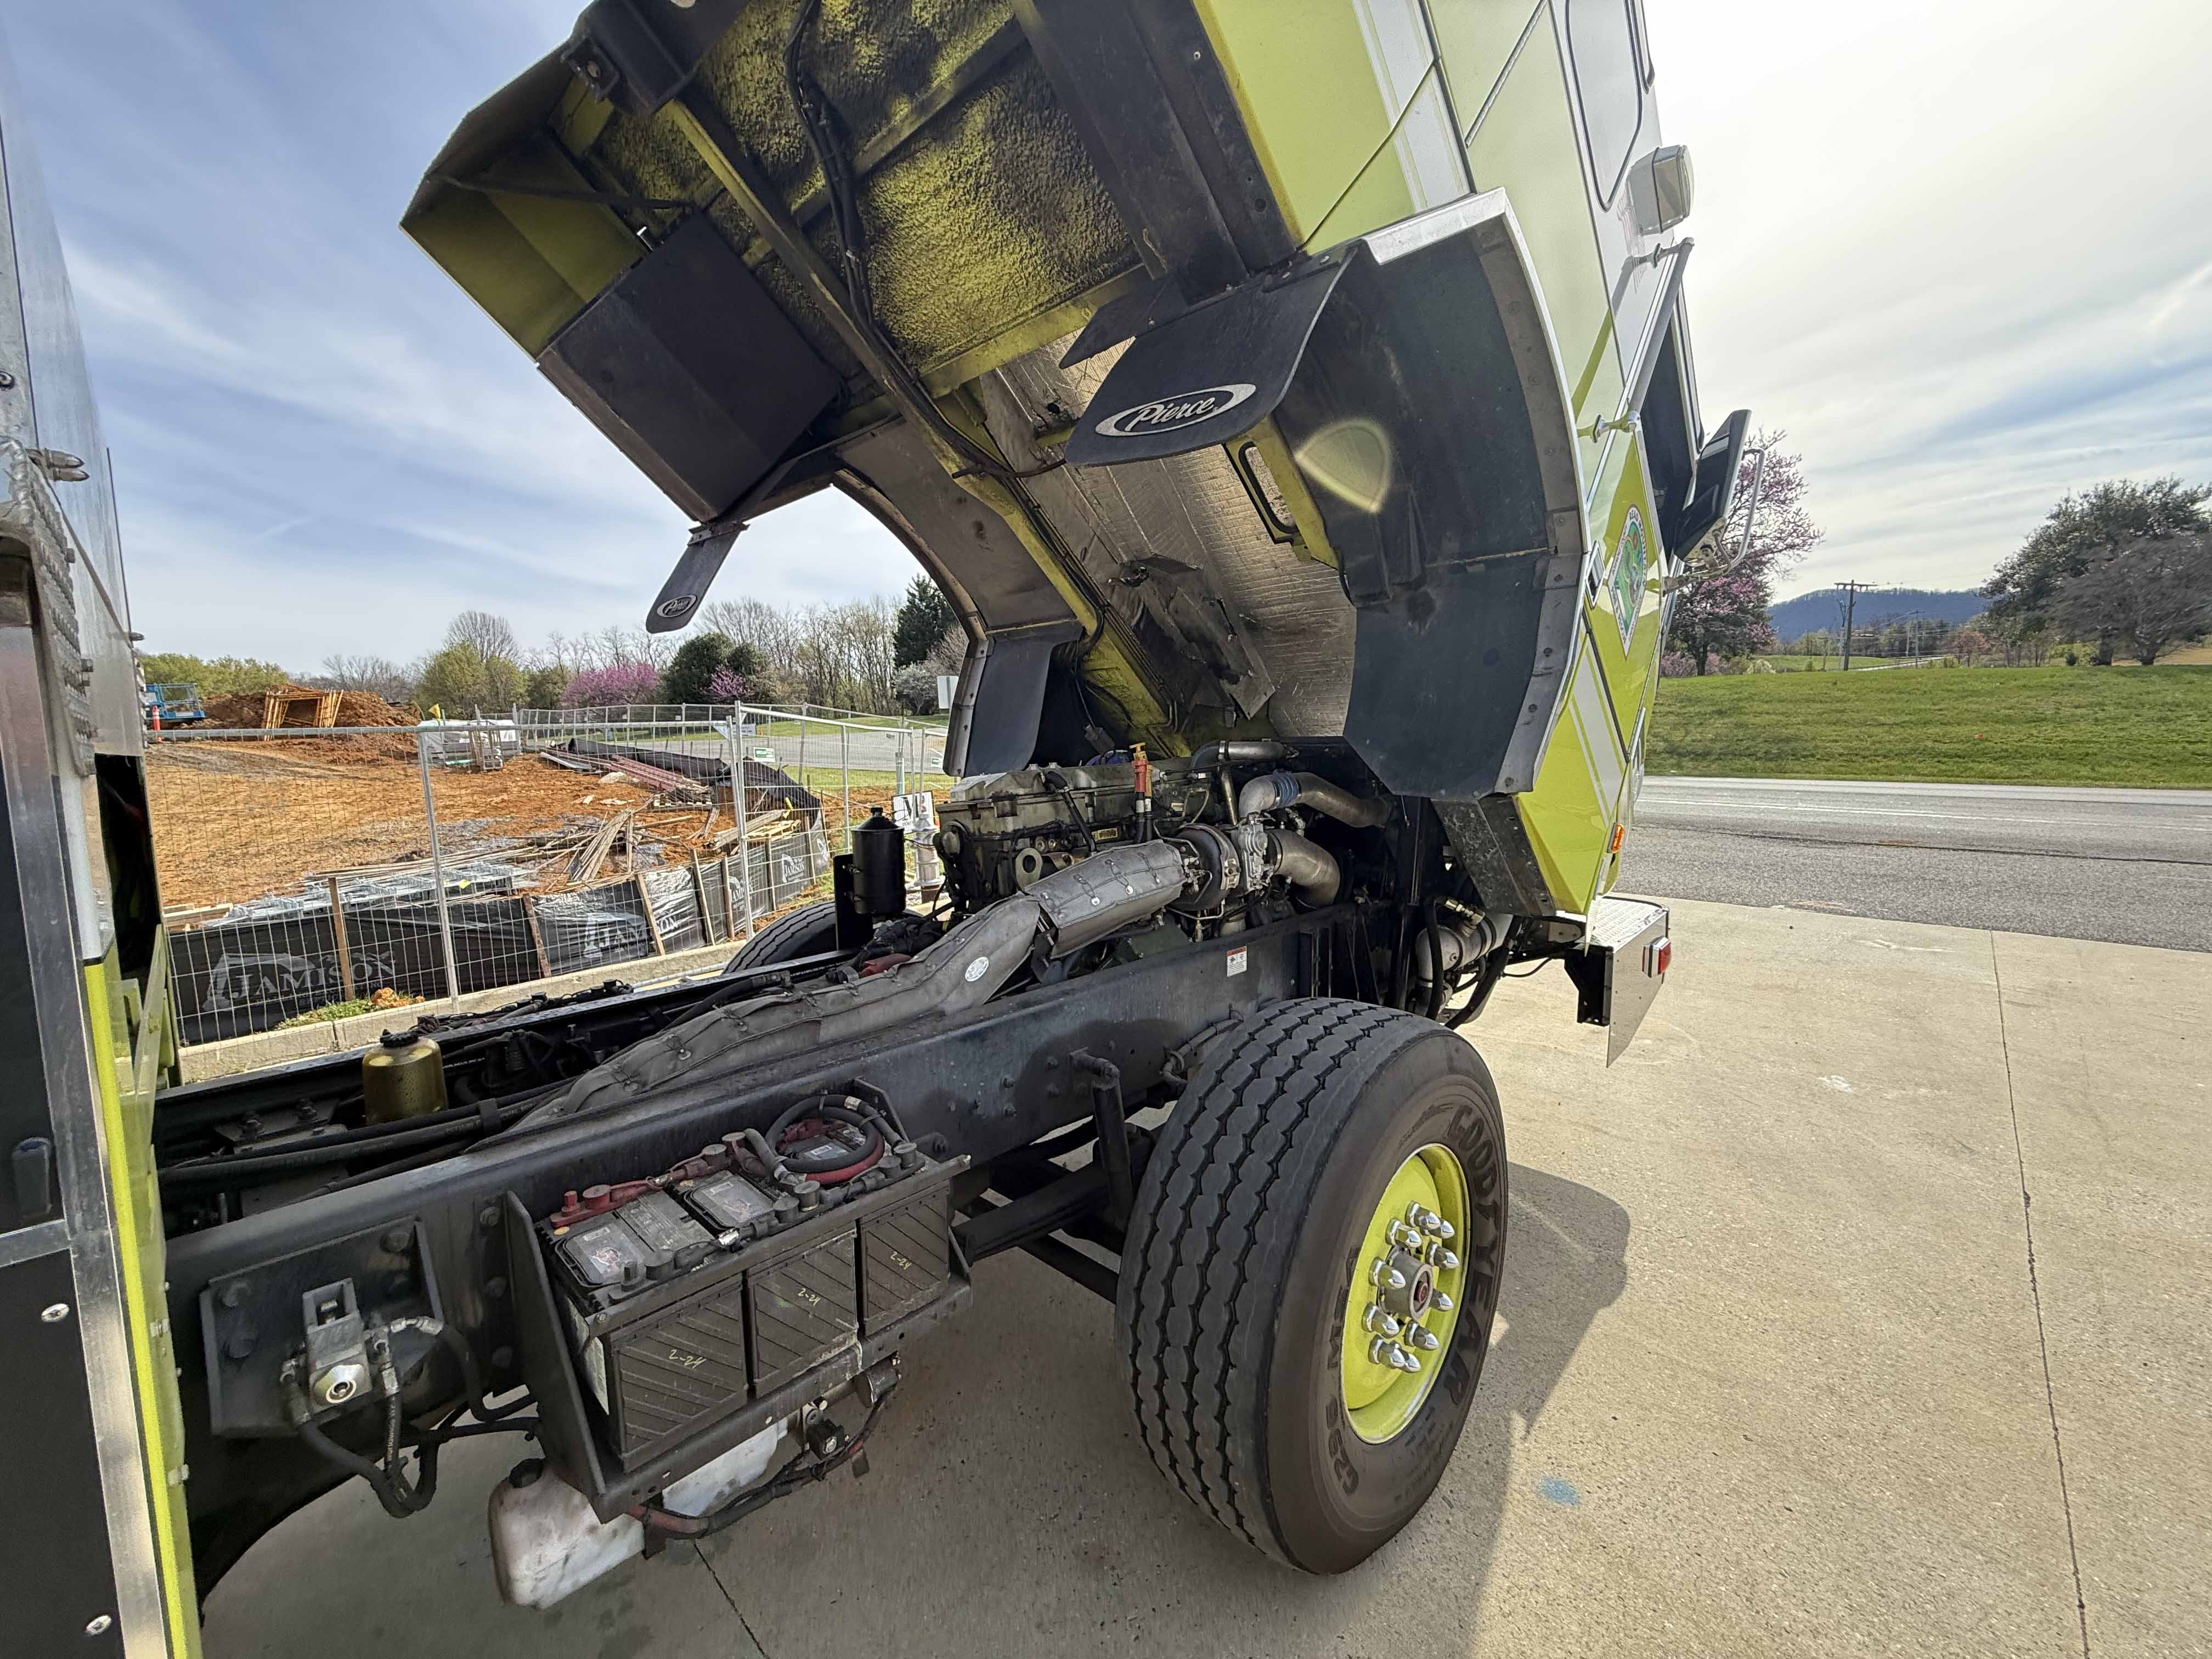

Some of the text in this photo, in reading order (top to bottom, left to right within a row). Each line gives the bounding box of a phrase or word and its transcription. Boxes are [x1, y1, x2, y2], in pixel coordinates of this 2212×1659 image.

[1124, 397, 1216, 432] Pierce
[221, 959, 396, 1000] JAMISON
[890, 1251, 912, 1270] 2-24
[1446, 1103, 1498, 1407] GOODYEAR
[797, 1288, 821, 1306] 2-24
[669, 1349, 707, 1369] 2-24
